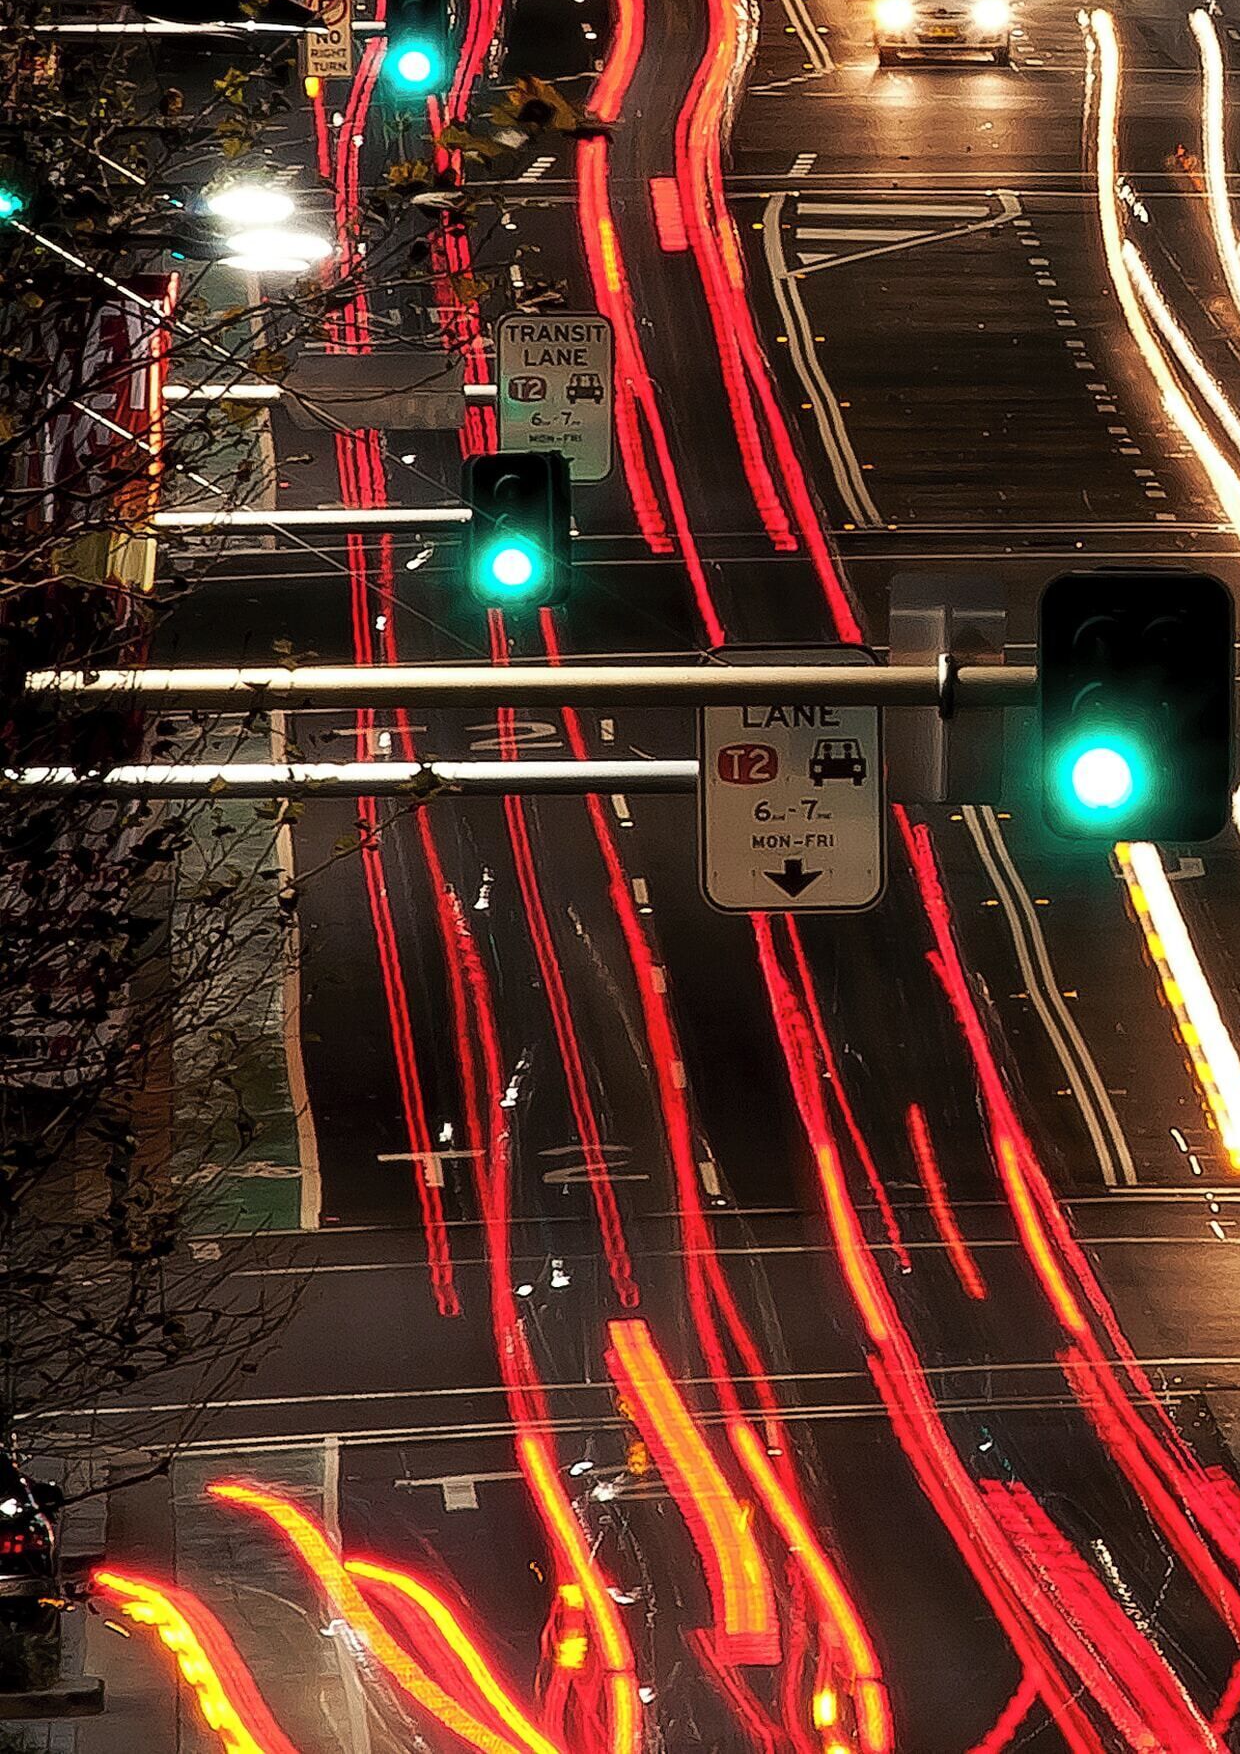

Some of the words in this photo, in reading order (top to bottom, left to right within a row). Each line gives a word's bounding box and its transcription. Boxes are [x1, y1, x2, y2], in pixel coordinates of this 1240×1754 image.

[316, 30, 341, 44] NO
[505, 324, 607, 343] TRANSIT
[524, 348, 588, 366] LANE
[512, 379, 542, 400] T2
[742, 705, 840, 729] LANE
[725, 749, 771, 781] T2
[751, 833, 834, 849] MON-FRI
